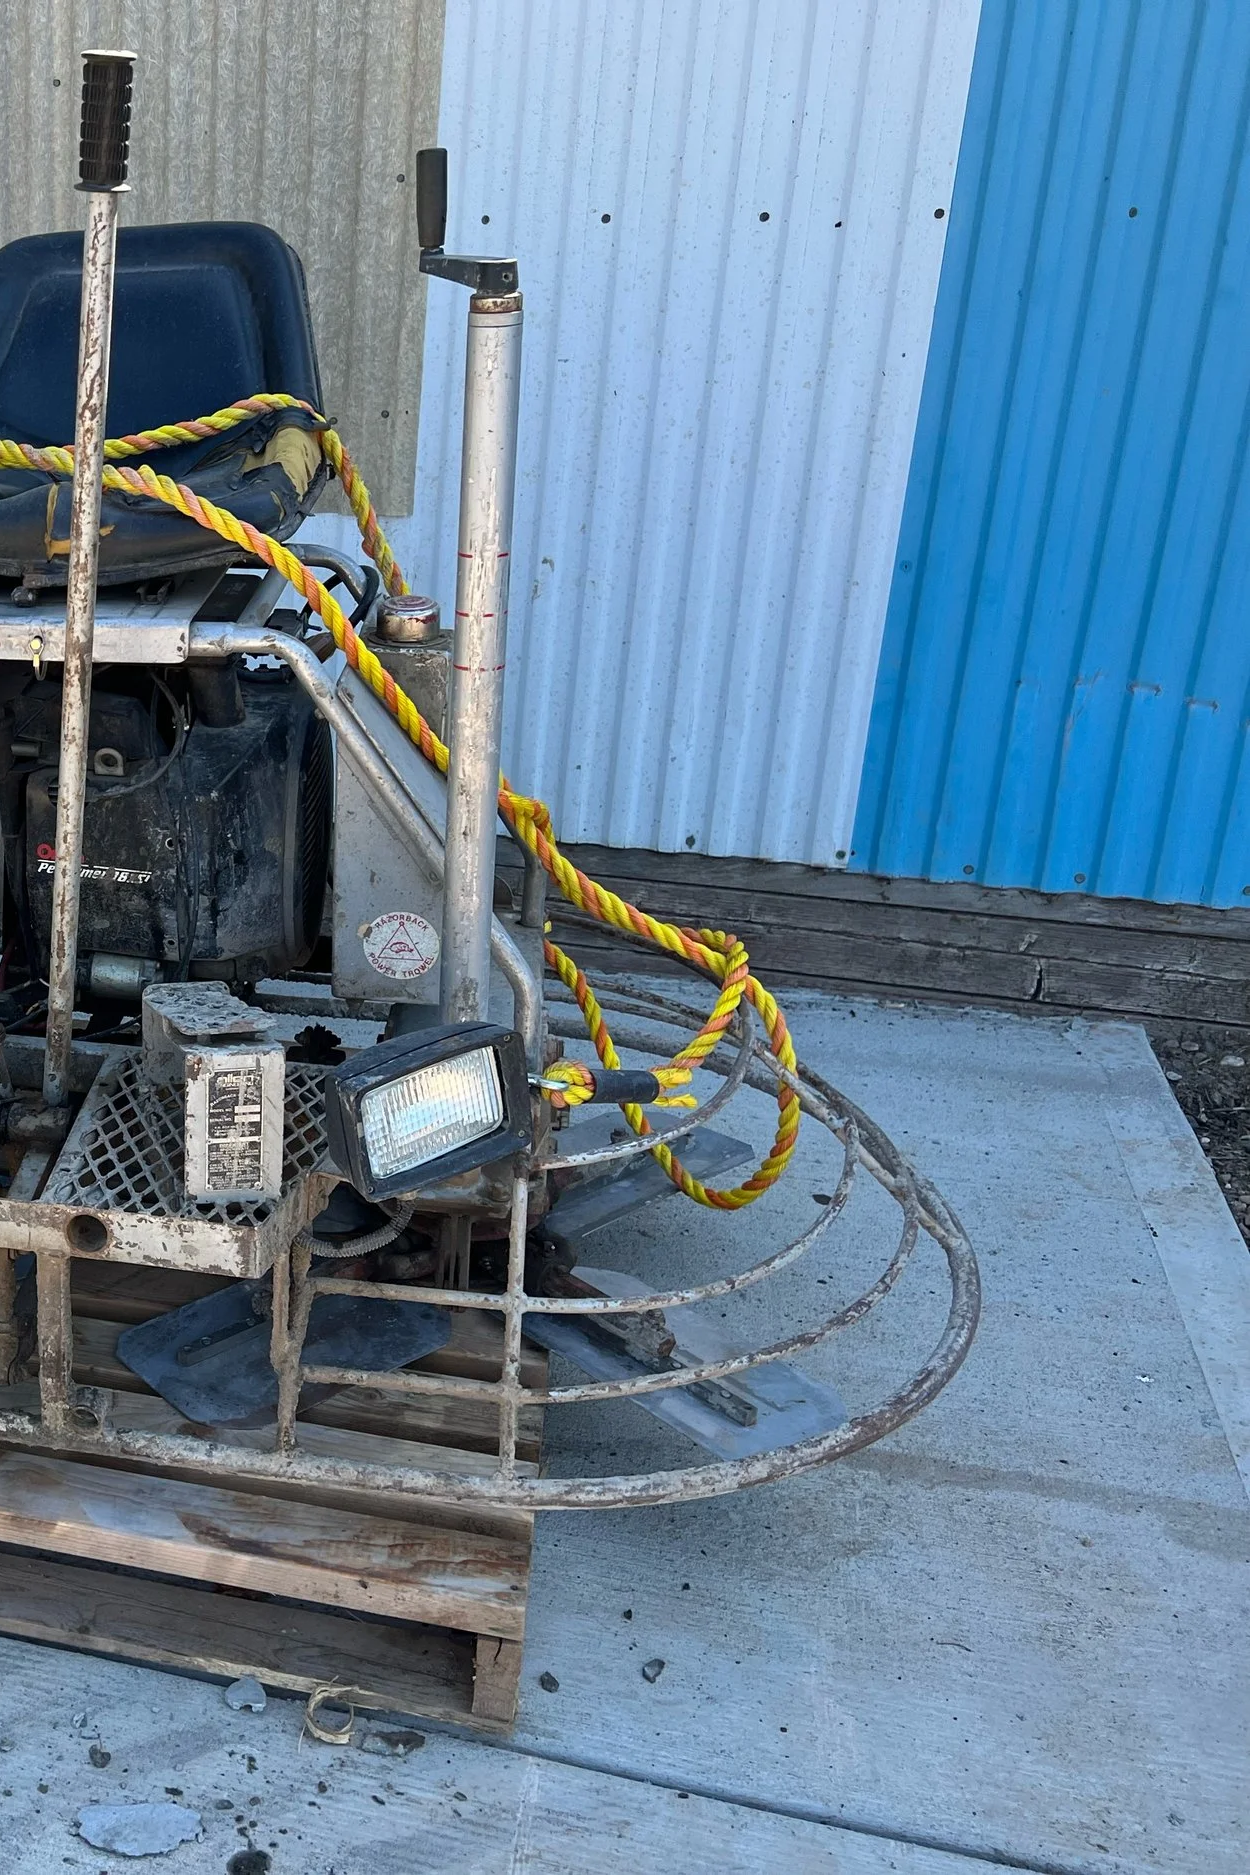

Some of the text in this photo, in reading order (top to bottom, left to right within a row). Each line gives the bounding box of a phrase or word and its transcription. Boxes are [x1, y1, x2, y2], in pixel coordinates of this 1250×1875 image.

[374, 914, 429, 931] RAZORBACK
[368, 952, 435, 978] POWER TROWEL
